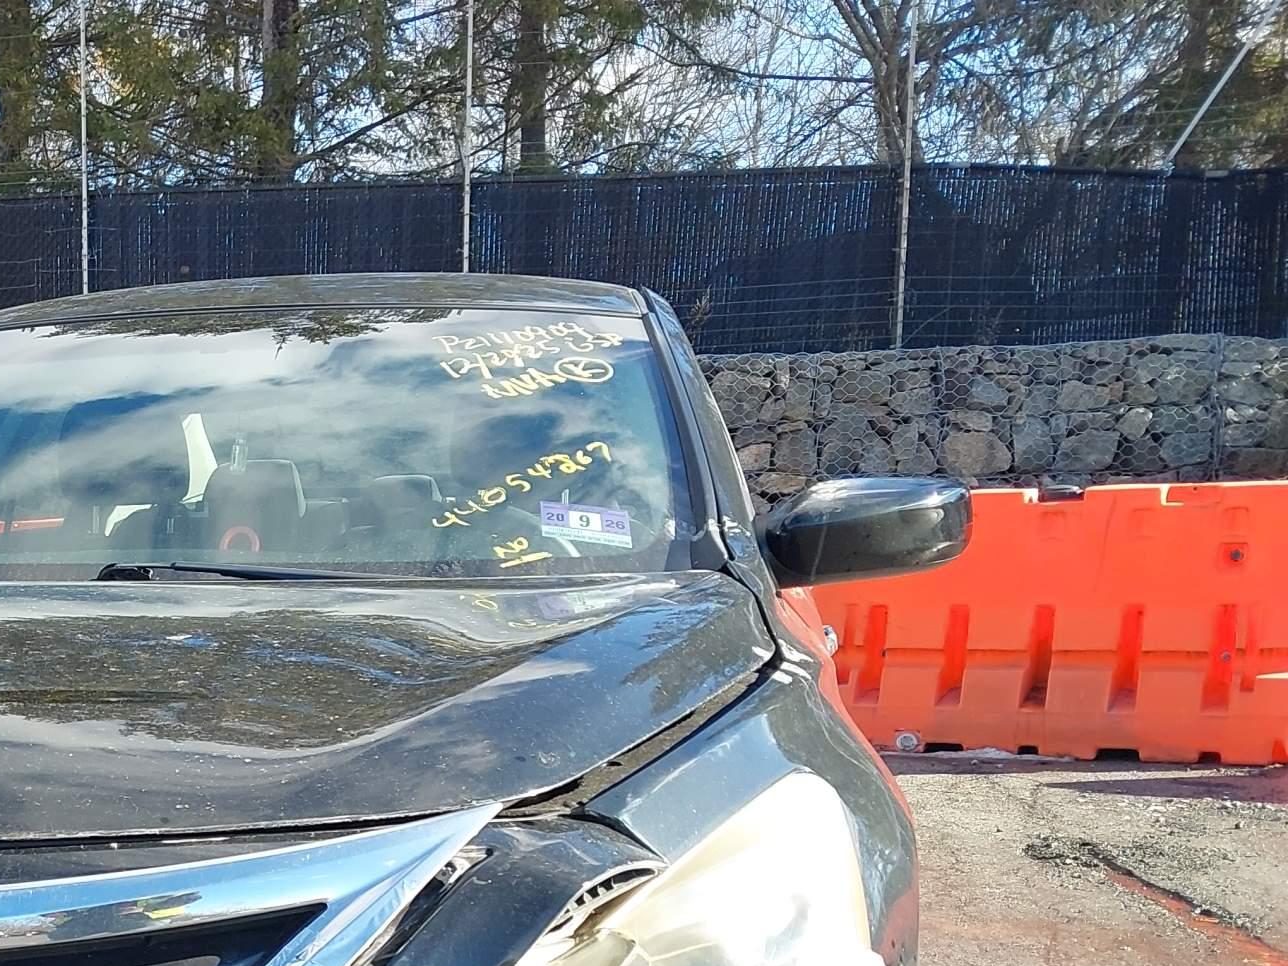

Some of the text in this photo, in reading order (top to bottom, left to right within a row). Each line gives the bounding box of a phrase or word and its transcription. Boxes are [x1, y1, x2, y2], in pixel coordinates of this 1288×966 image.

[546, 511, 626, 530] 20 9 26
